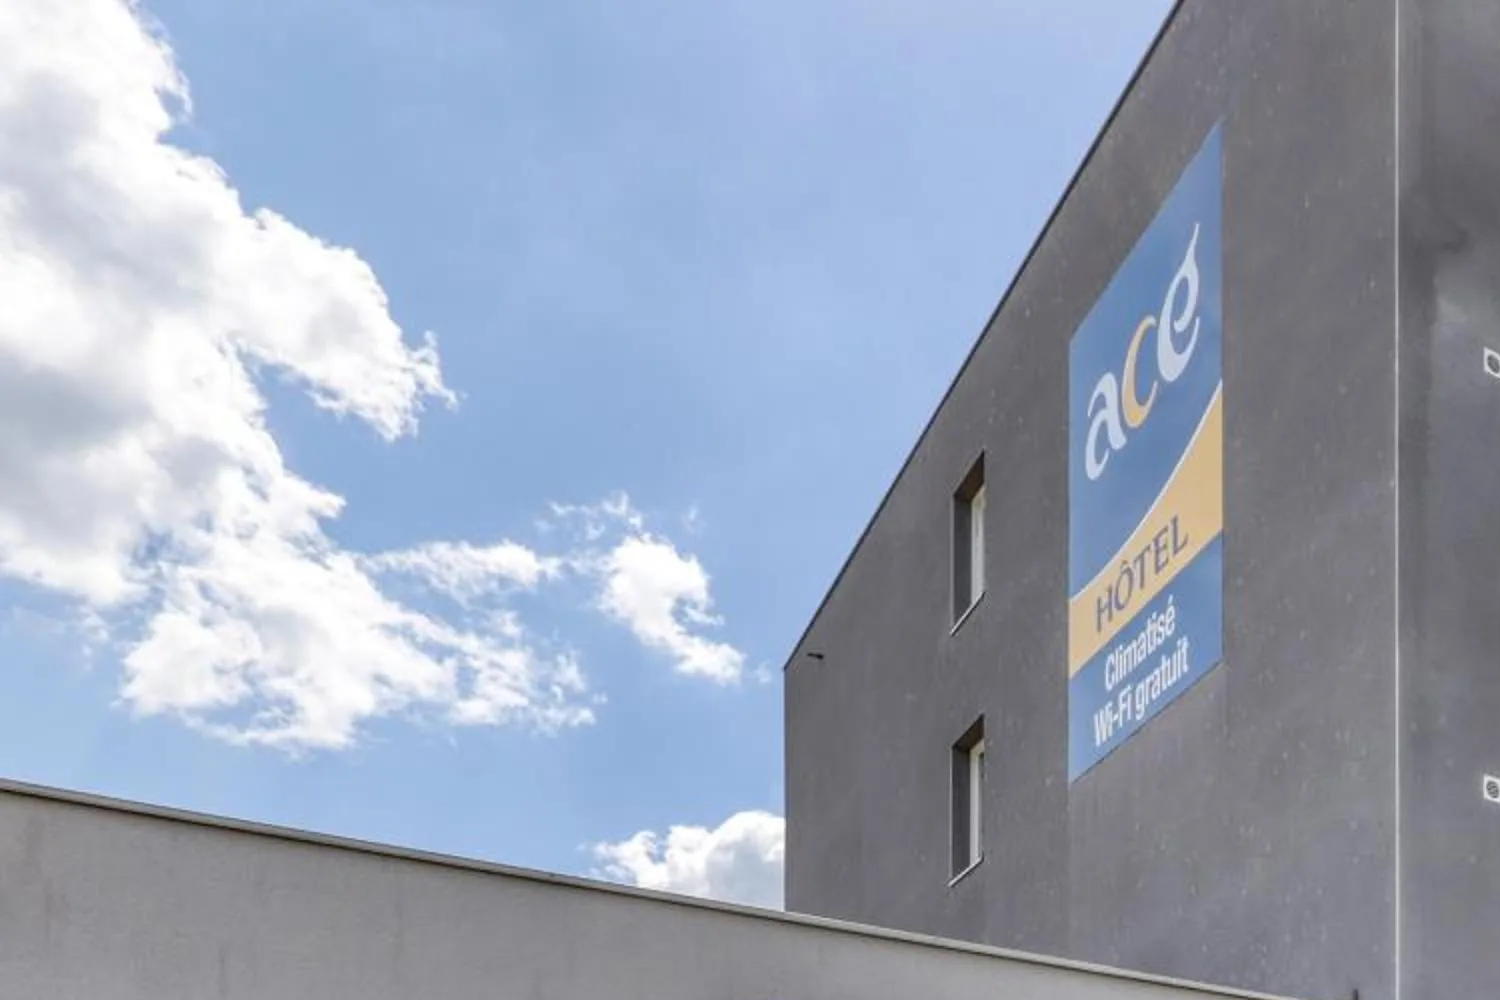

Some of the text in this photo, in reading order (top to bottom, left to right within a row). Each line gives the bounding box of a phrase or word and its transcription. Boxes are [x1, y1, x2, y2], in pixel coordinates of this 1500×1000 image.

[1085, 221, 1200, 480] ace
[1096, 514, 1189, 633] HÔTEL
[1093, 635, 1190, 747] Wi-Fi gratuit
[1104, 593, 1176, 691] Climatisé
